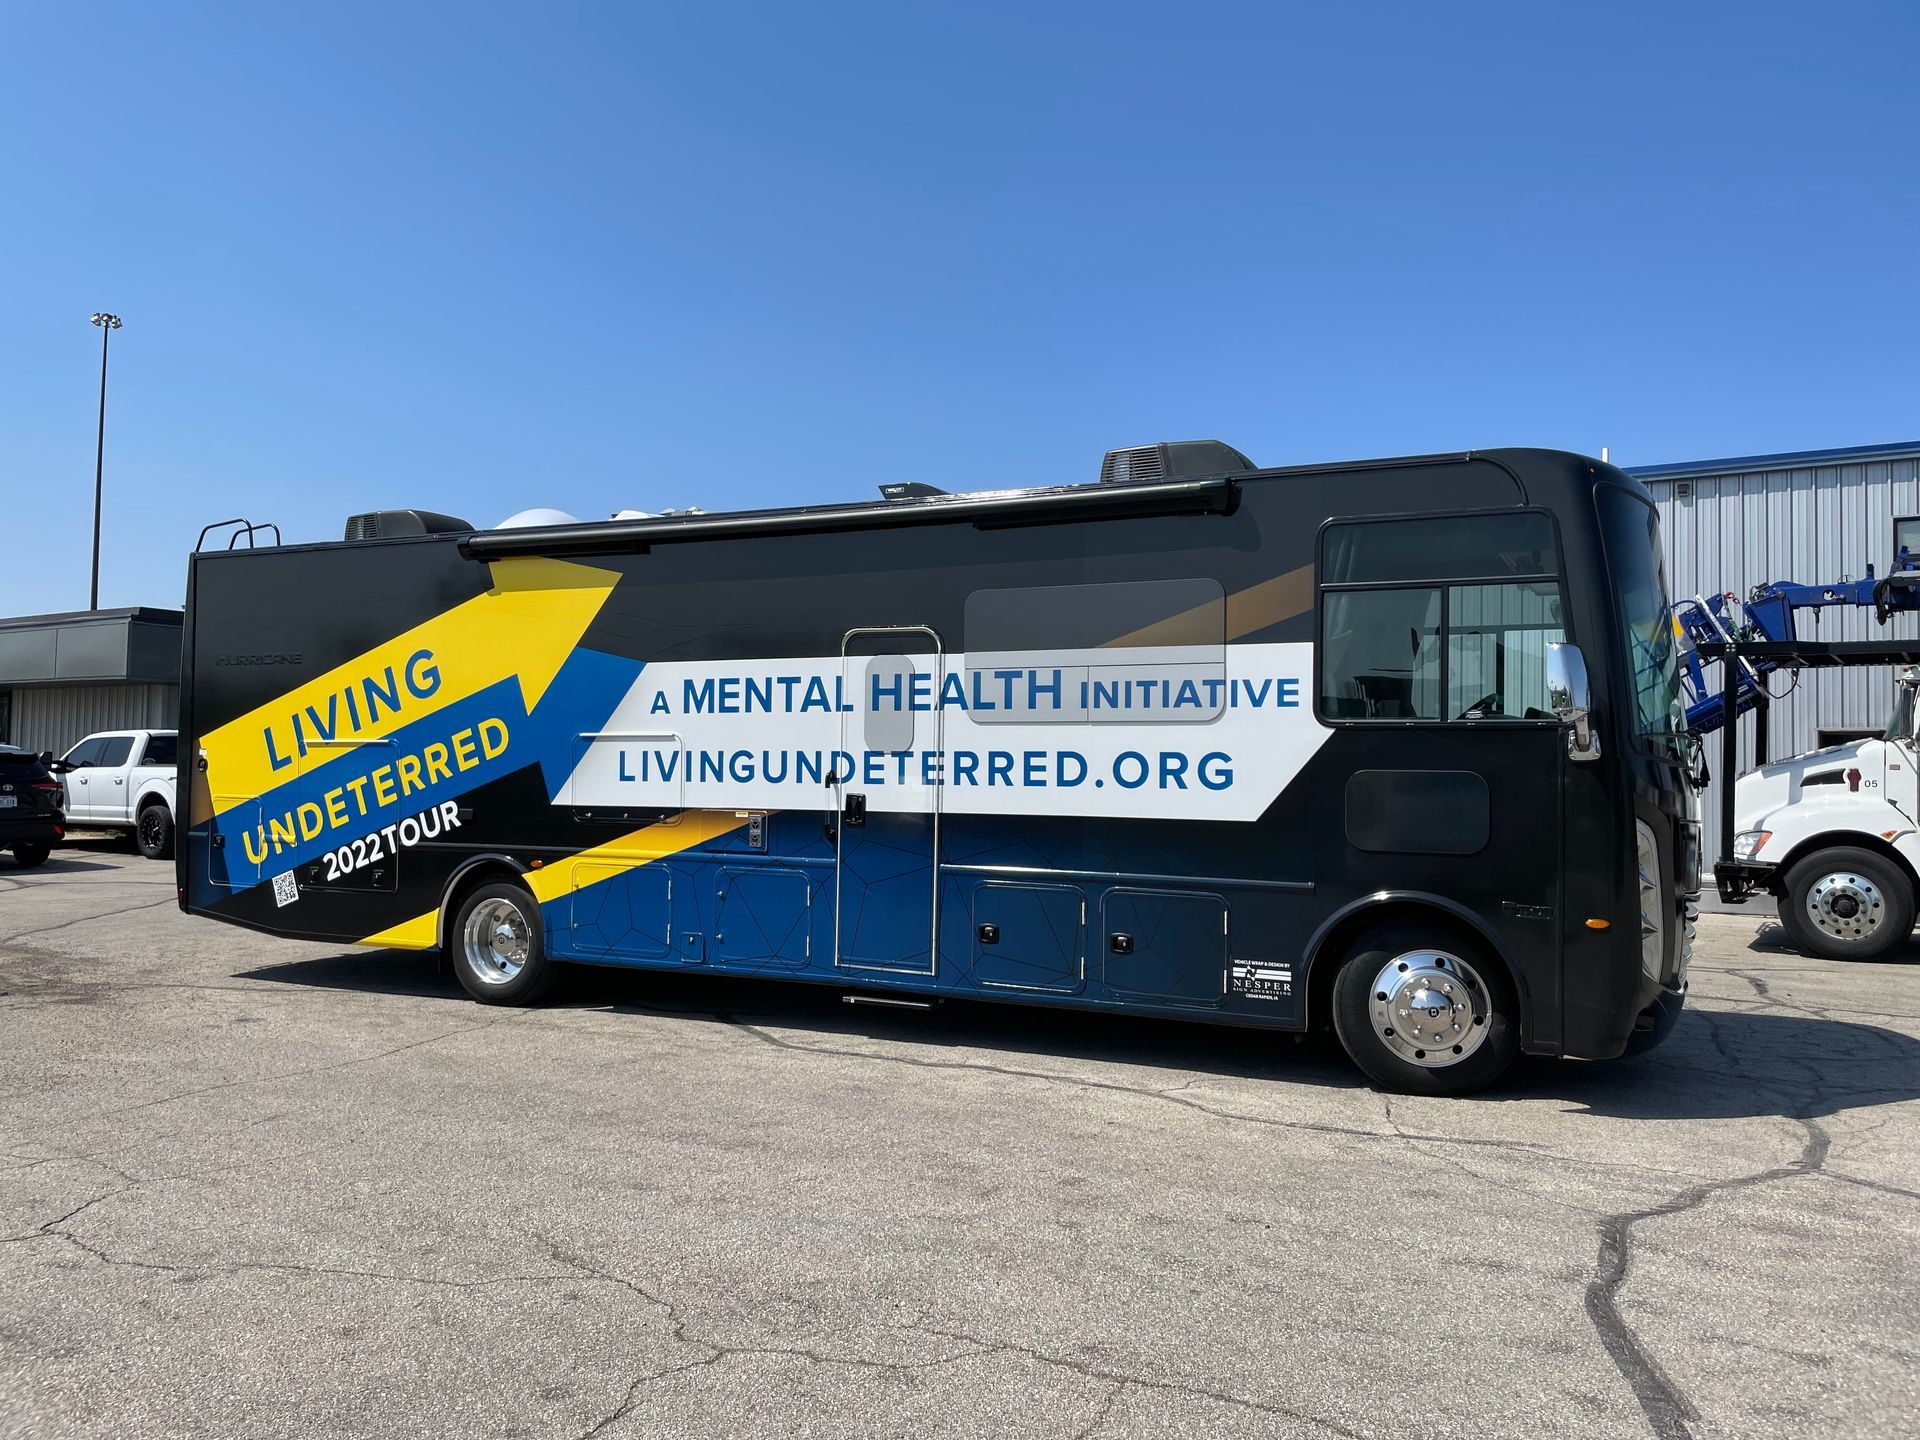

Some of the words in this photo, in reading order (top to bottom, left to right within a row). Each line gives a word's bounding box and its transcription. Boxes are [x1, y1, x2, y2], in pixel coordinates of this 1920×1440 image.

[215, 652, 303, 667] HURRICANE
[264, 648, 442, 773] LIVING
[650, 690, 671, 715] A
[683, 675, 854, 714] MENTAL
[871, 669, 1062, 712] HEALTH
[1080, 678, 1300, 710] INITIATIVE
[242, 716, 510, 866] UNDETERRED
[619, 750, 1234, 791] LIVINGUNDETERRED.ORG
[1864, 779, 1878, 788] 05
[1233, 978, 1292, 992] NESPER
